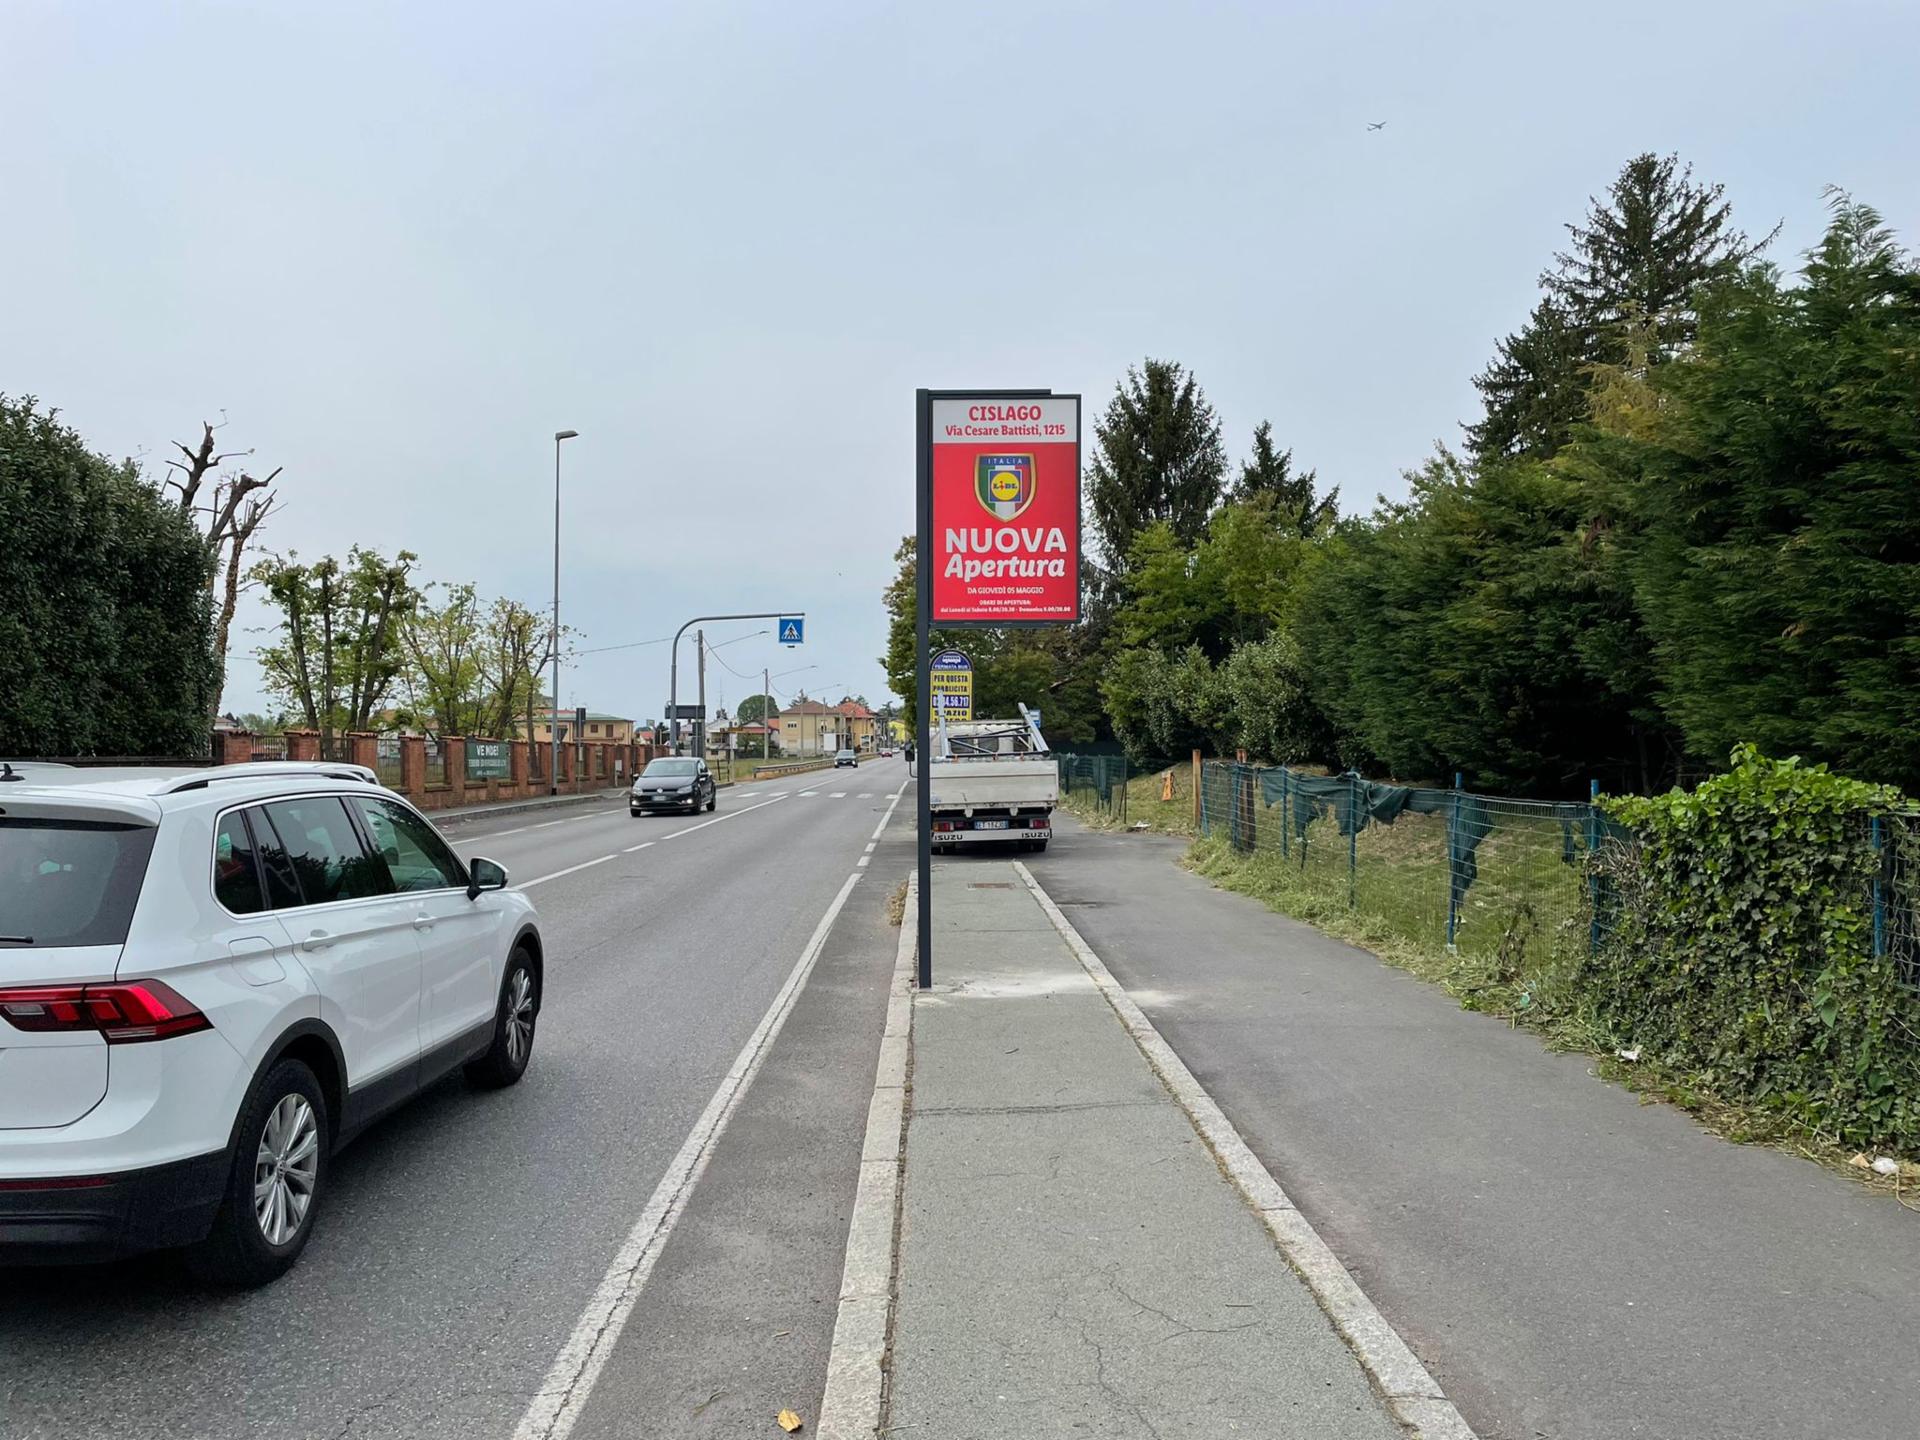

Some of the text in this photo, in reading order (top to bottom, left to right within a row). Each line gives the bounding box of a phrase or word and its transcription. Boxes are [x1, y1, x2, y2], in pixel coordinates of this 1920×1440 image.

[968, 405, 1042, 421] CISLAGO
[945, 424, 1065, 437] Via Cesare Battisti, 1215
[945, 527, 1067, 553] NUOVA
[944, 553, 1065, 583] Apertura
[1007, 586, 1015, 594] 05
[1016, 586, 1044, 594] MAGGIO
[934, 674, 968, 683] PER QUESTA
